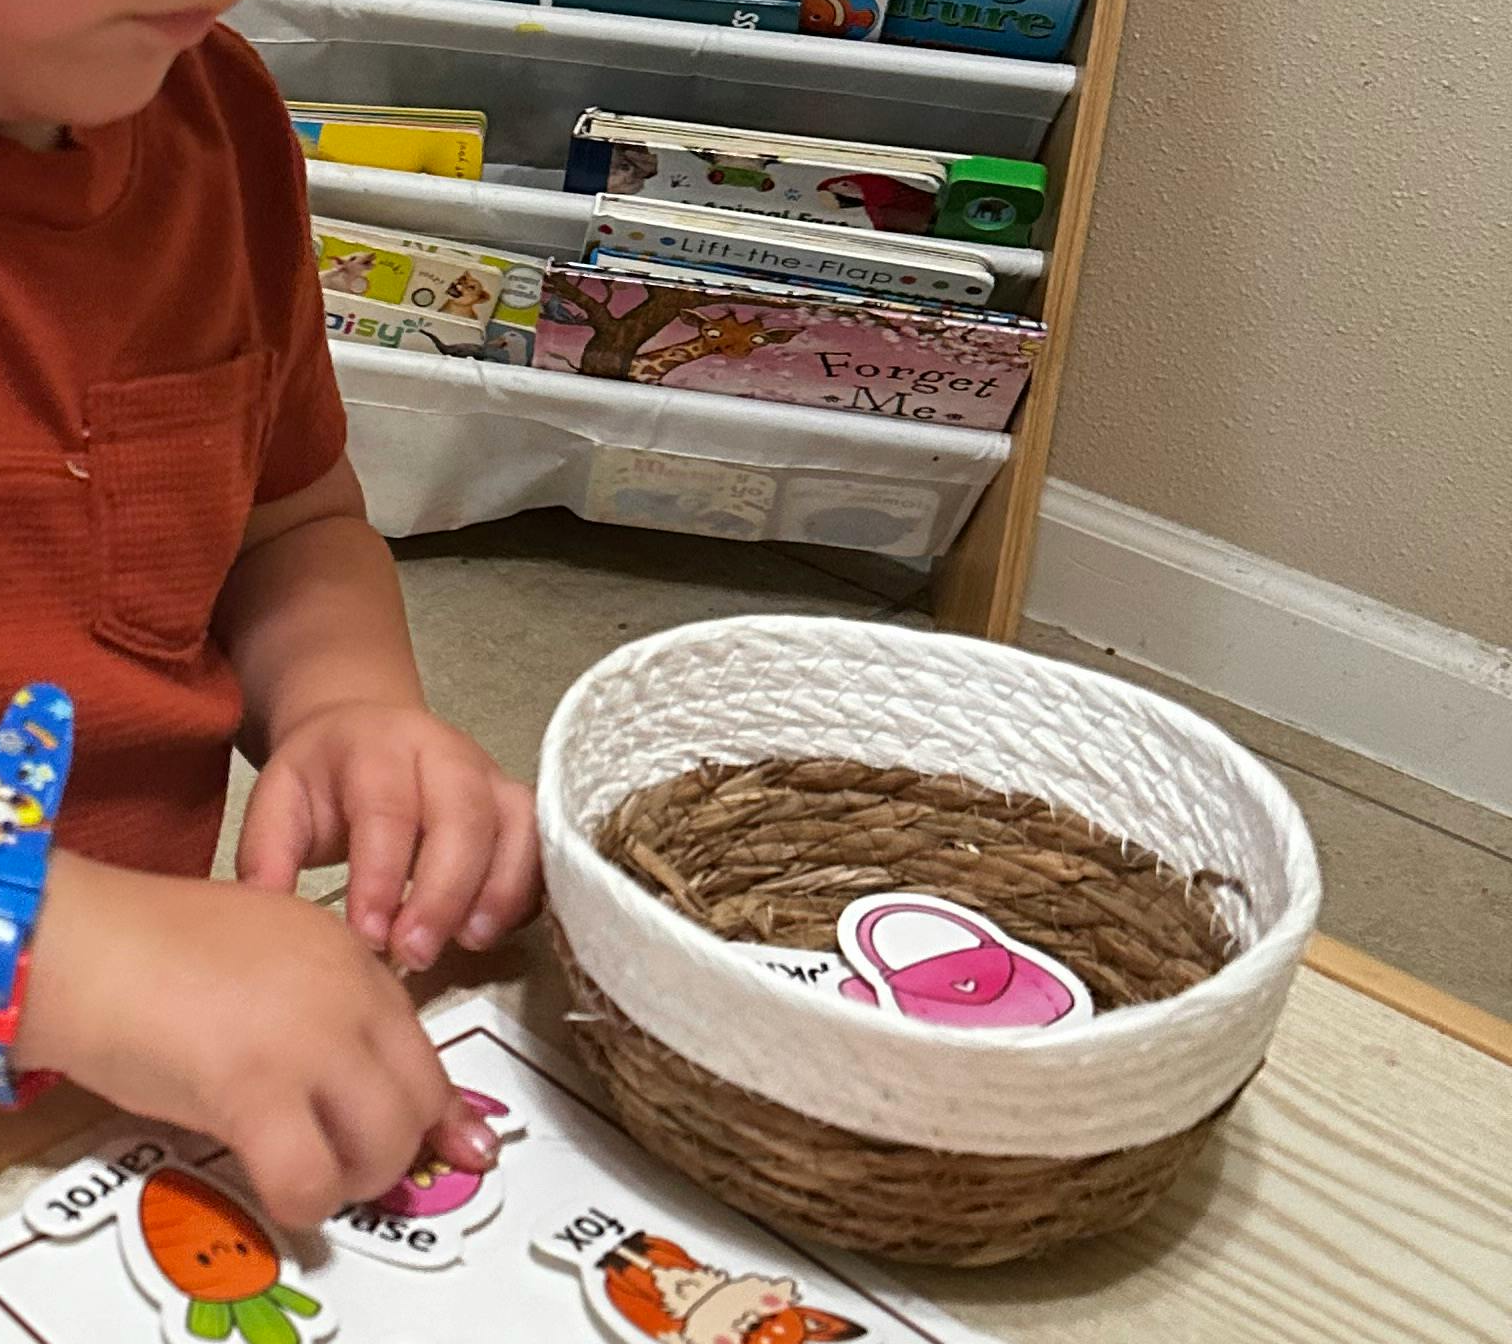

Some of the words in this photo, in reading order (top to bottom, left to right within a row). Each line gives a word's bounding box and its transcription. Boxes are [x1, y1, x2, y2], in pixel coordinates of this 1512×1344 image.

[680, 238, 893, 285] Lift-the-Flap
[814, 351, 1000, 399] Forget
[843, 385, 937, 420] Me
[46, 1142, 165, 1222] carrot
[553, 1206, 625, 1252] fox
